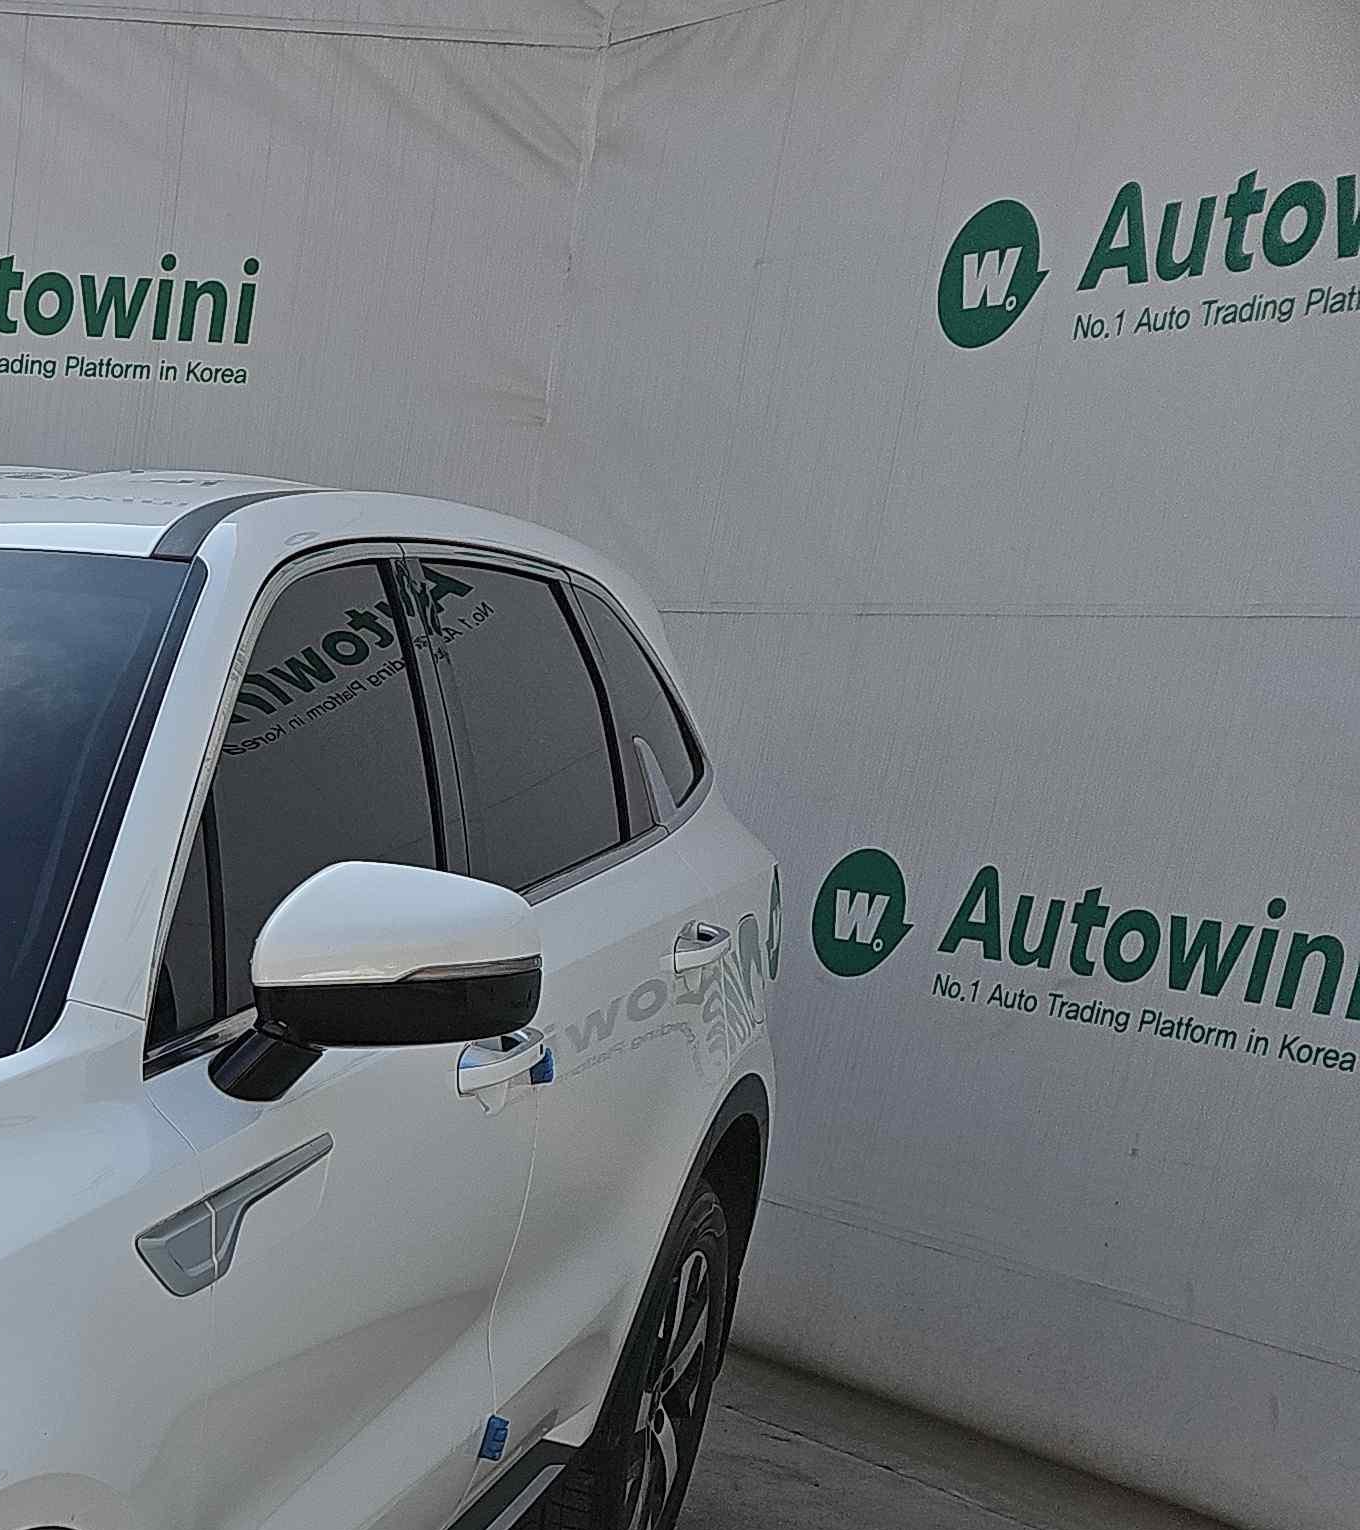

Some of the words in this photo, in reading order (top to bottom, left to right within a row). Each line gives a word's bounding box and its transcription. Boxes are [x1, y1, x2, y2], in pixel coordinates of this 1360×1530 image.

[1073, 309, 1126, 341] No.1
[1133, 305, 1191, 334] Auto
[1201, 294, 1296, 323] Trading
[64, 355, 151, 380] Platform
[159, 360, 178, 382] in
[185, 361, 247, 384] Korea
[931, 973, 980, 1003] No.1
[986, 983, 1038, 1013] Auto
[1048, 992, 1131, 1034] Trading
[1137, 1008, 1238, 1050] Platform
[1245, 1028, 1269, 1057] in
[1277, 1033, 1357, 1073] Korea
